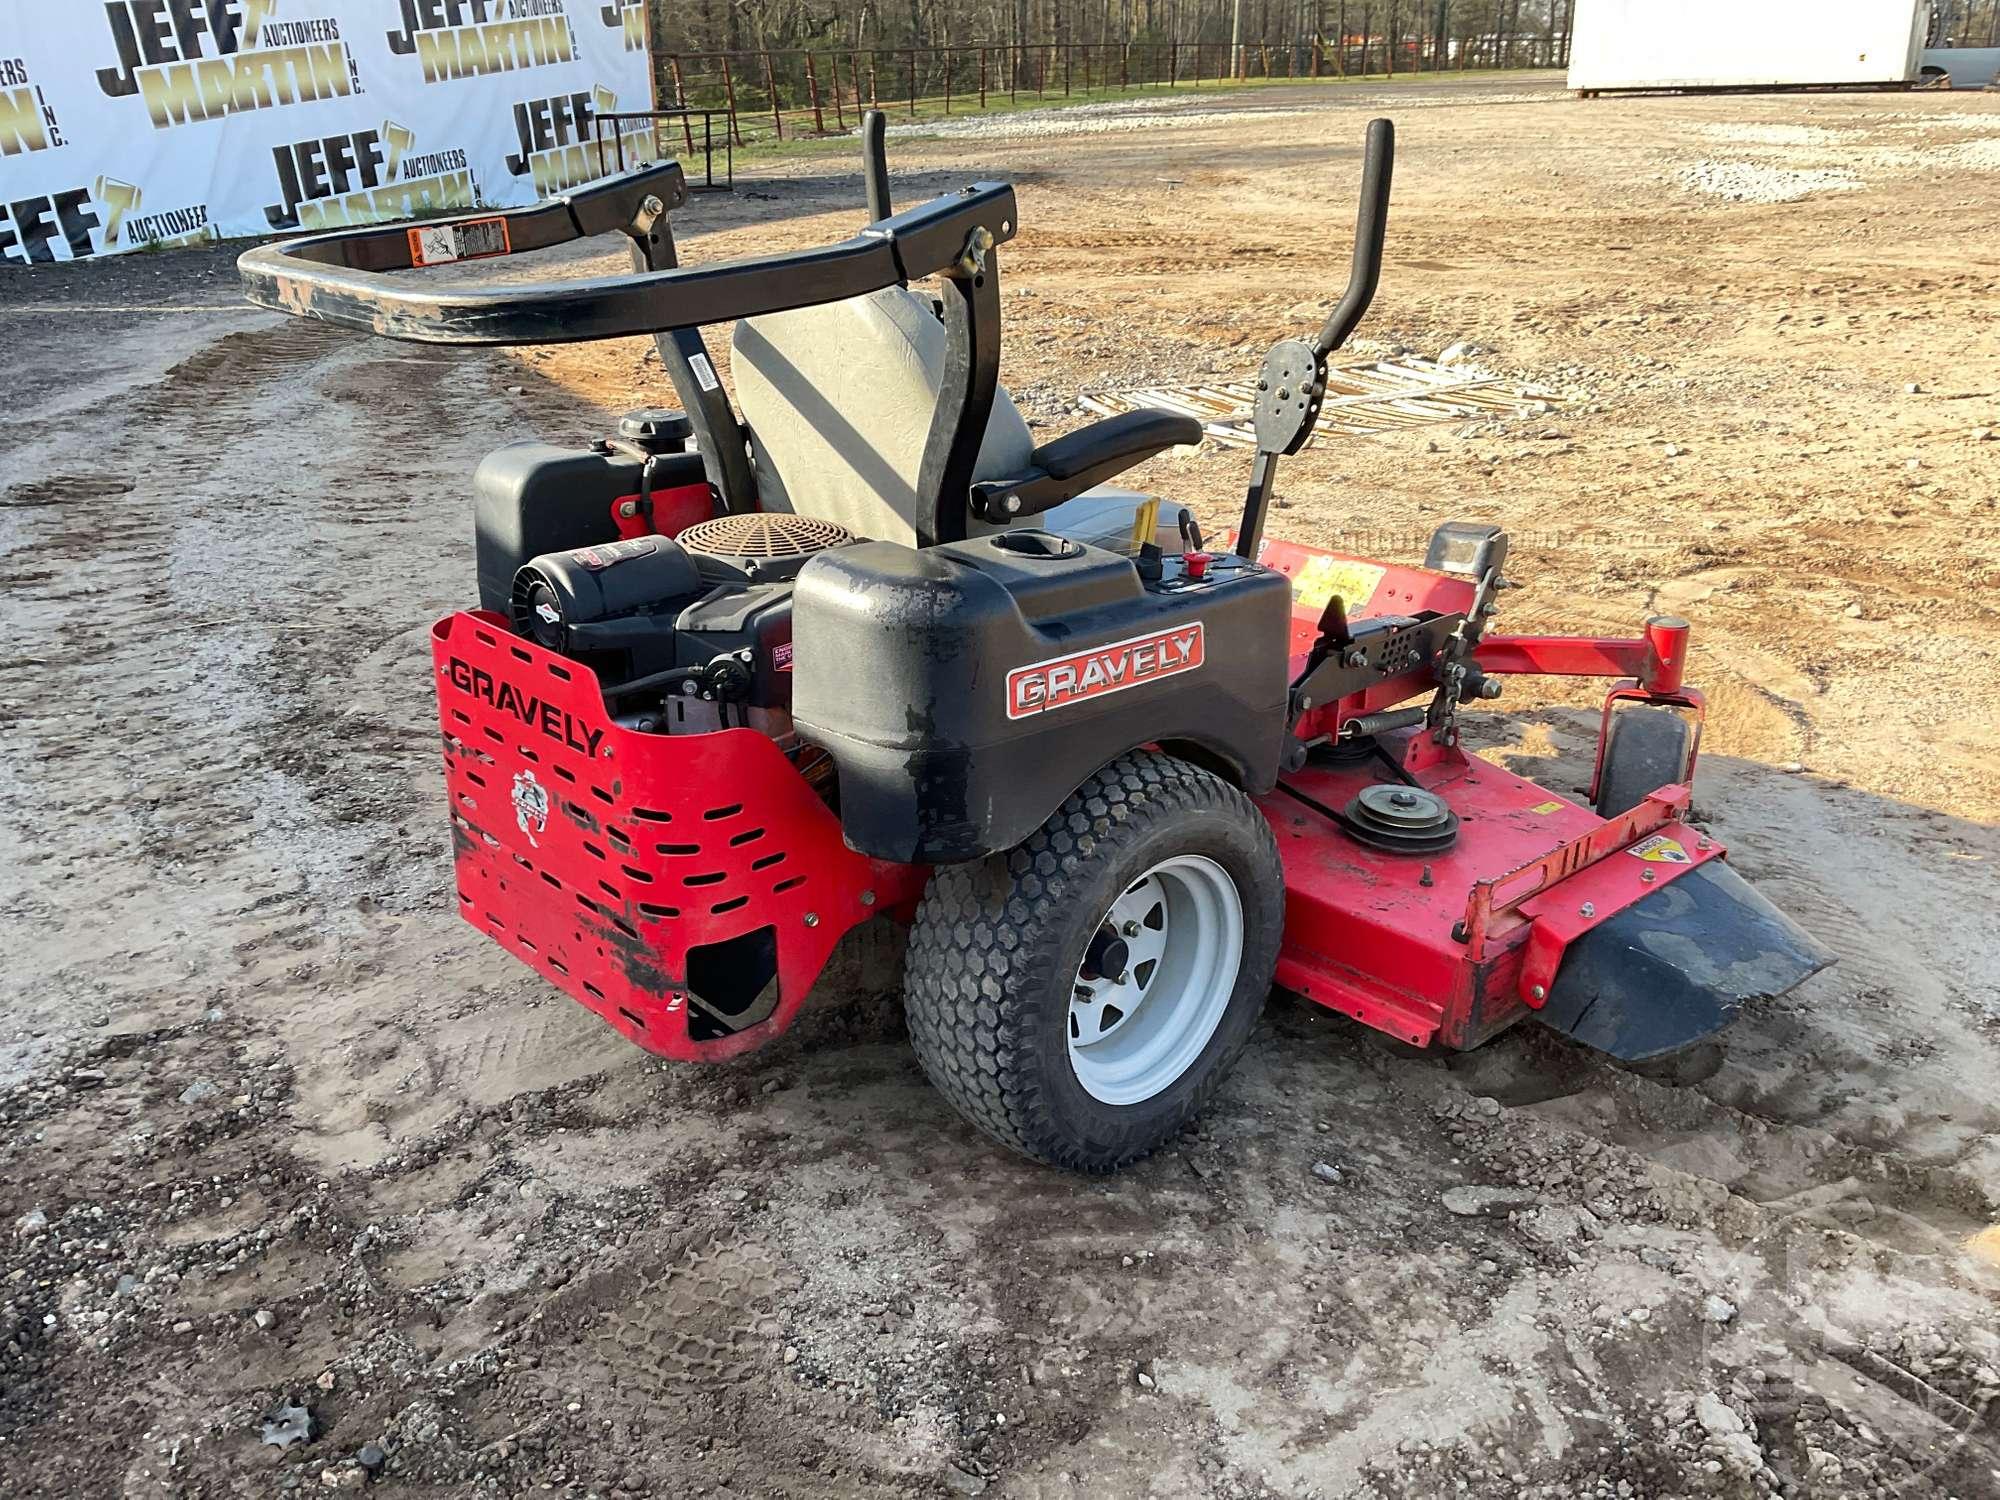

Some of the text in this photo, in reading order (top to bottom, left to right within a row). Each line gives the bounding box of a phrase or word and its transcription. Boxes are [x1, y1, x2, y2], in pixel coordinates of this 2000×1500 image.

[95, 0, 340, 97] JEFF AUCTIONEERS
[137, 43, 351, 129] MARTIN
[345, 41, 366, 95] INC.
[415, 16, 572, 84] MARTIN
[35, 85, 69, 147] INC.
[505, 91, 595, 176] JEFF
[264, 129, 467, 230] JEFF AUCTIONEERS
[450, 655, 605, 758] GRAVELY
[1016, 630, 1198, 710] GRAVELY
